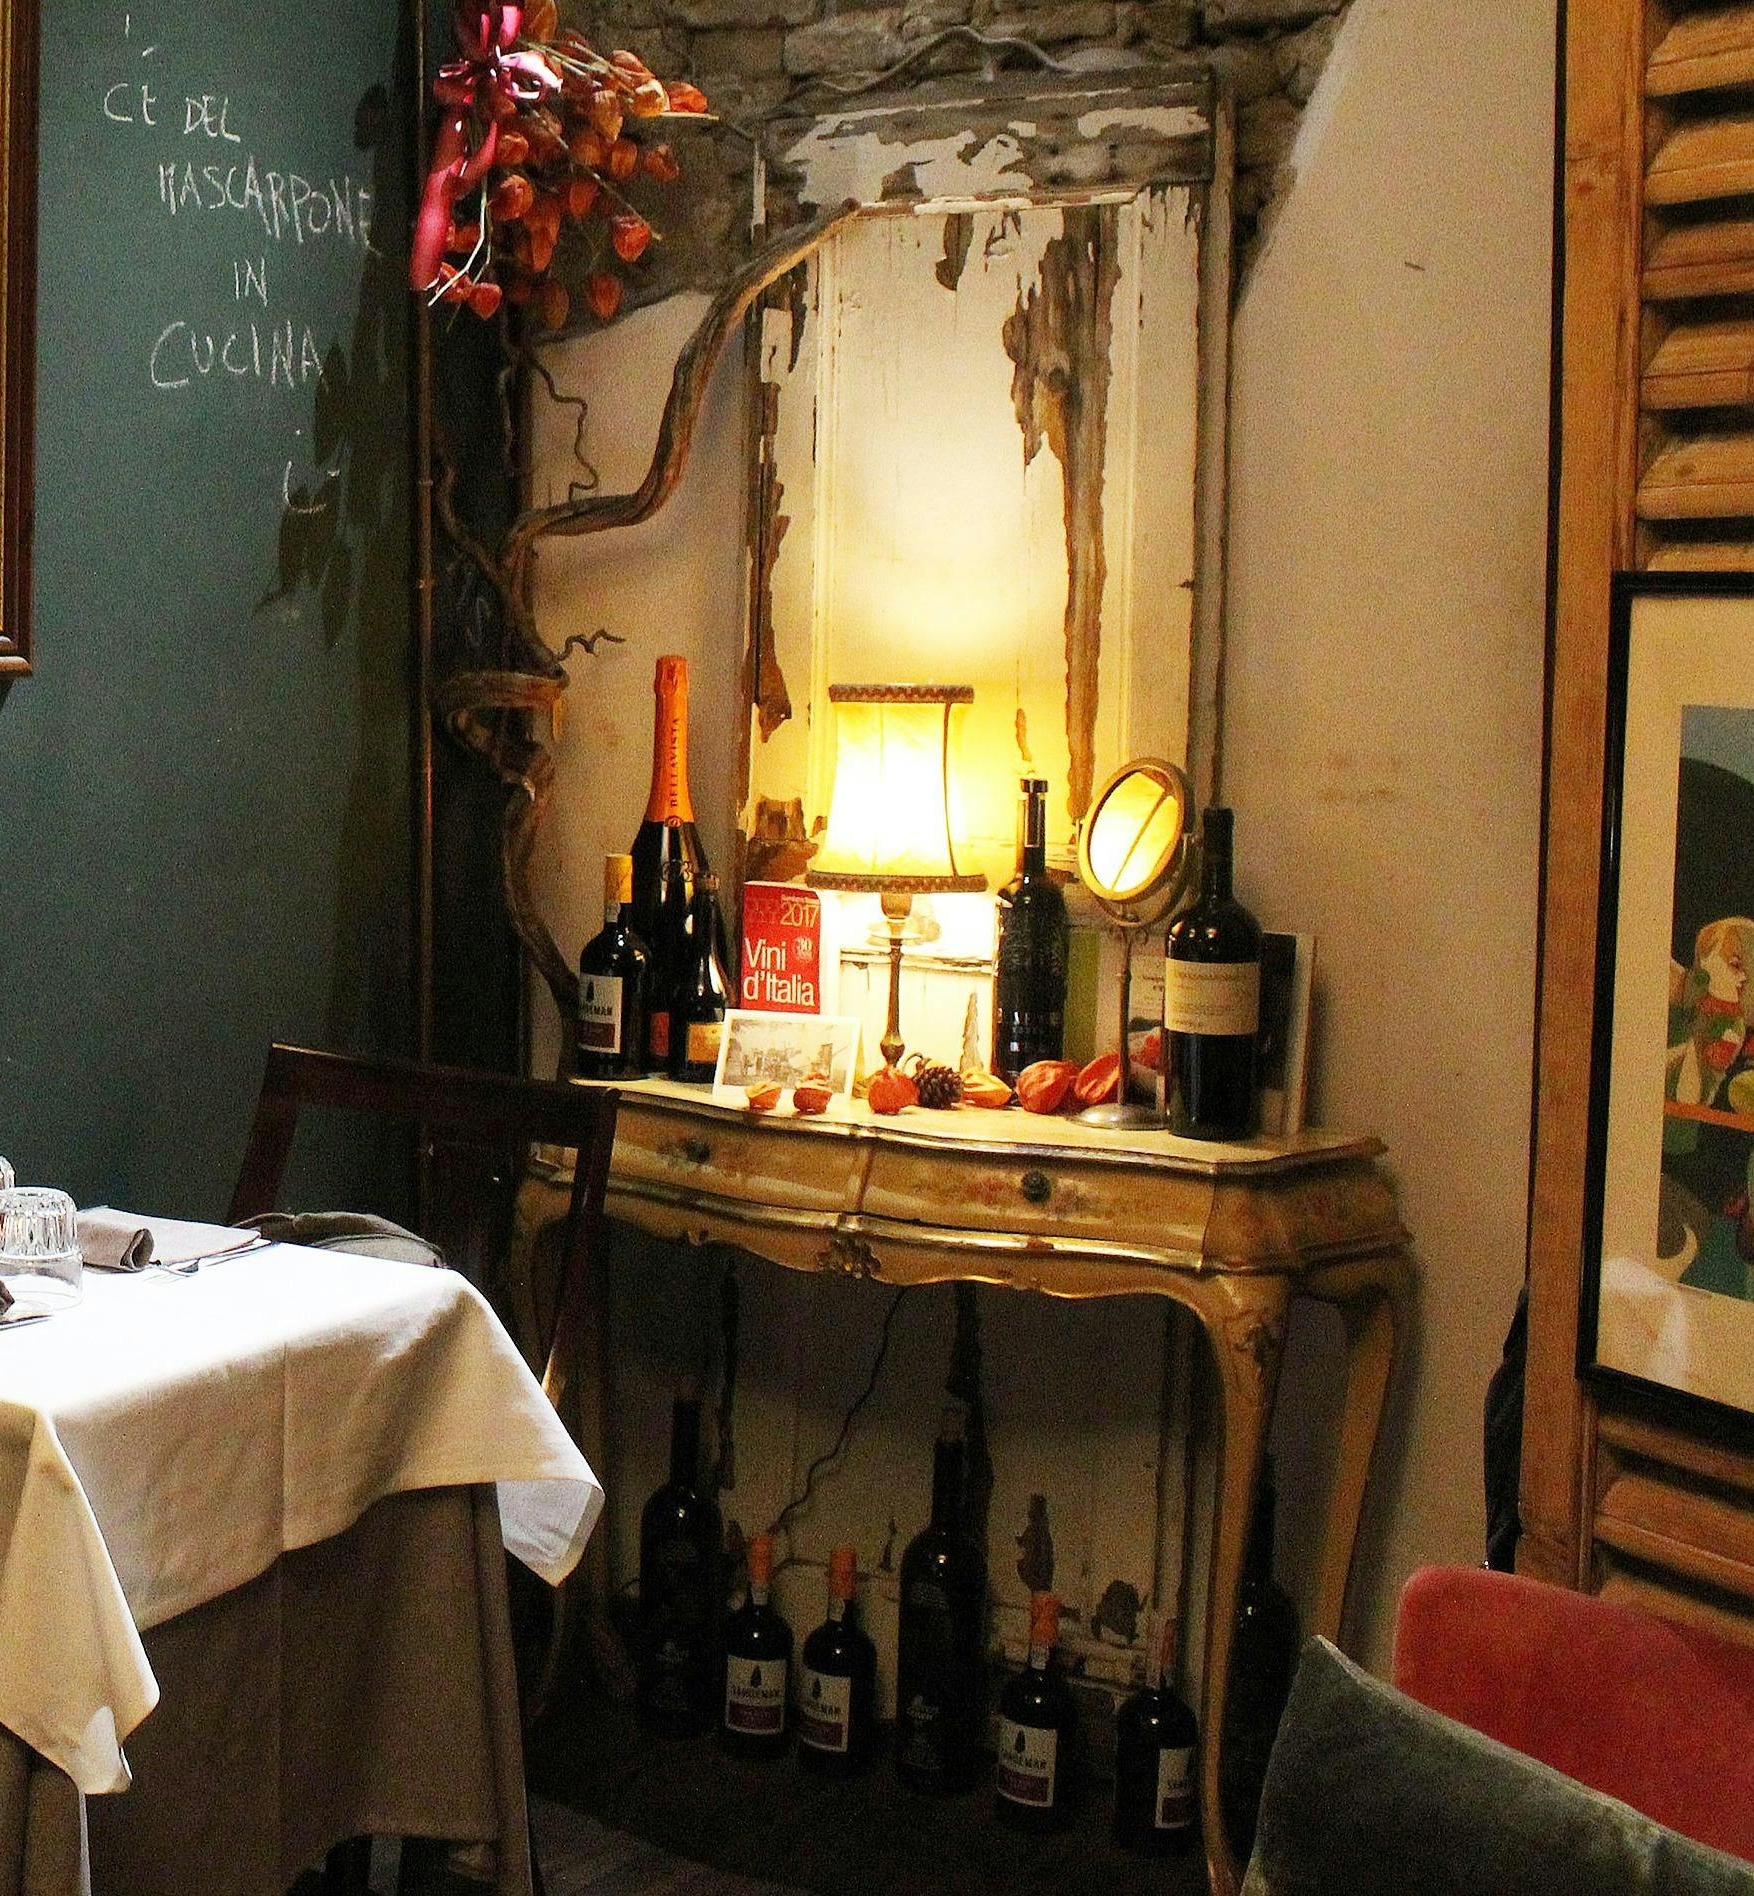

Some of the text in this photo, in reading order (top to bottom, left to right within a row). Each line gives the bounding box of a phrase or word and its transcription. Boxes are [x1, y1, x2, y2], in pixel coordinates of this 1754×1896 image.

[183, 95, 242, 144] DEL
[158, 154, 383, 258] MASCARPONE
[233, 256, 268, 307] IN
[150, 320, 330, 390] CUCINA
[779, 901, 820, 928] 2017
[744, 937, 786, 971] Vini
[743, 969, 816, 1007] d'Italia
